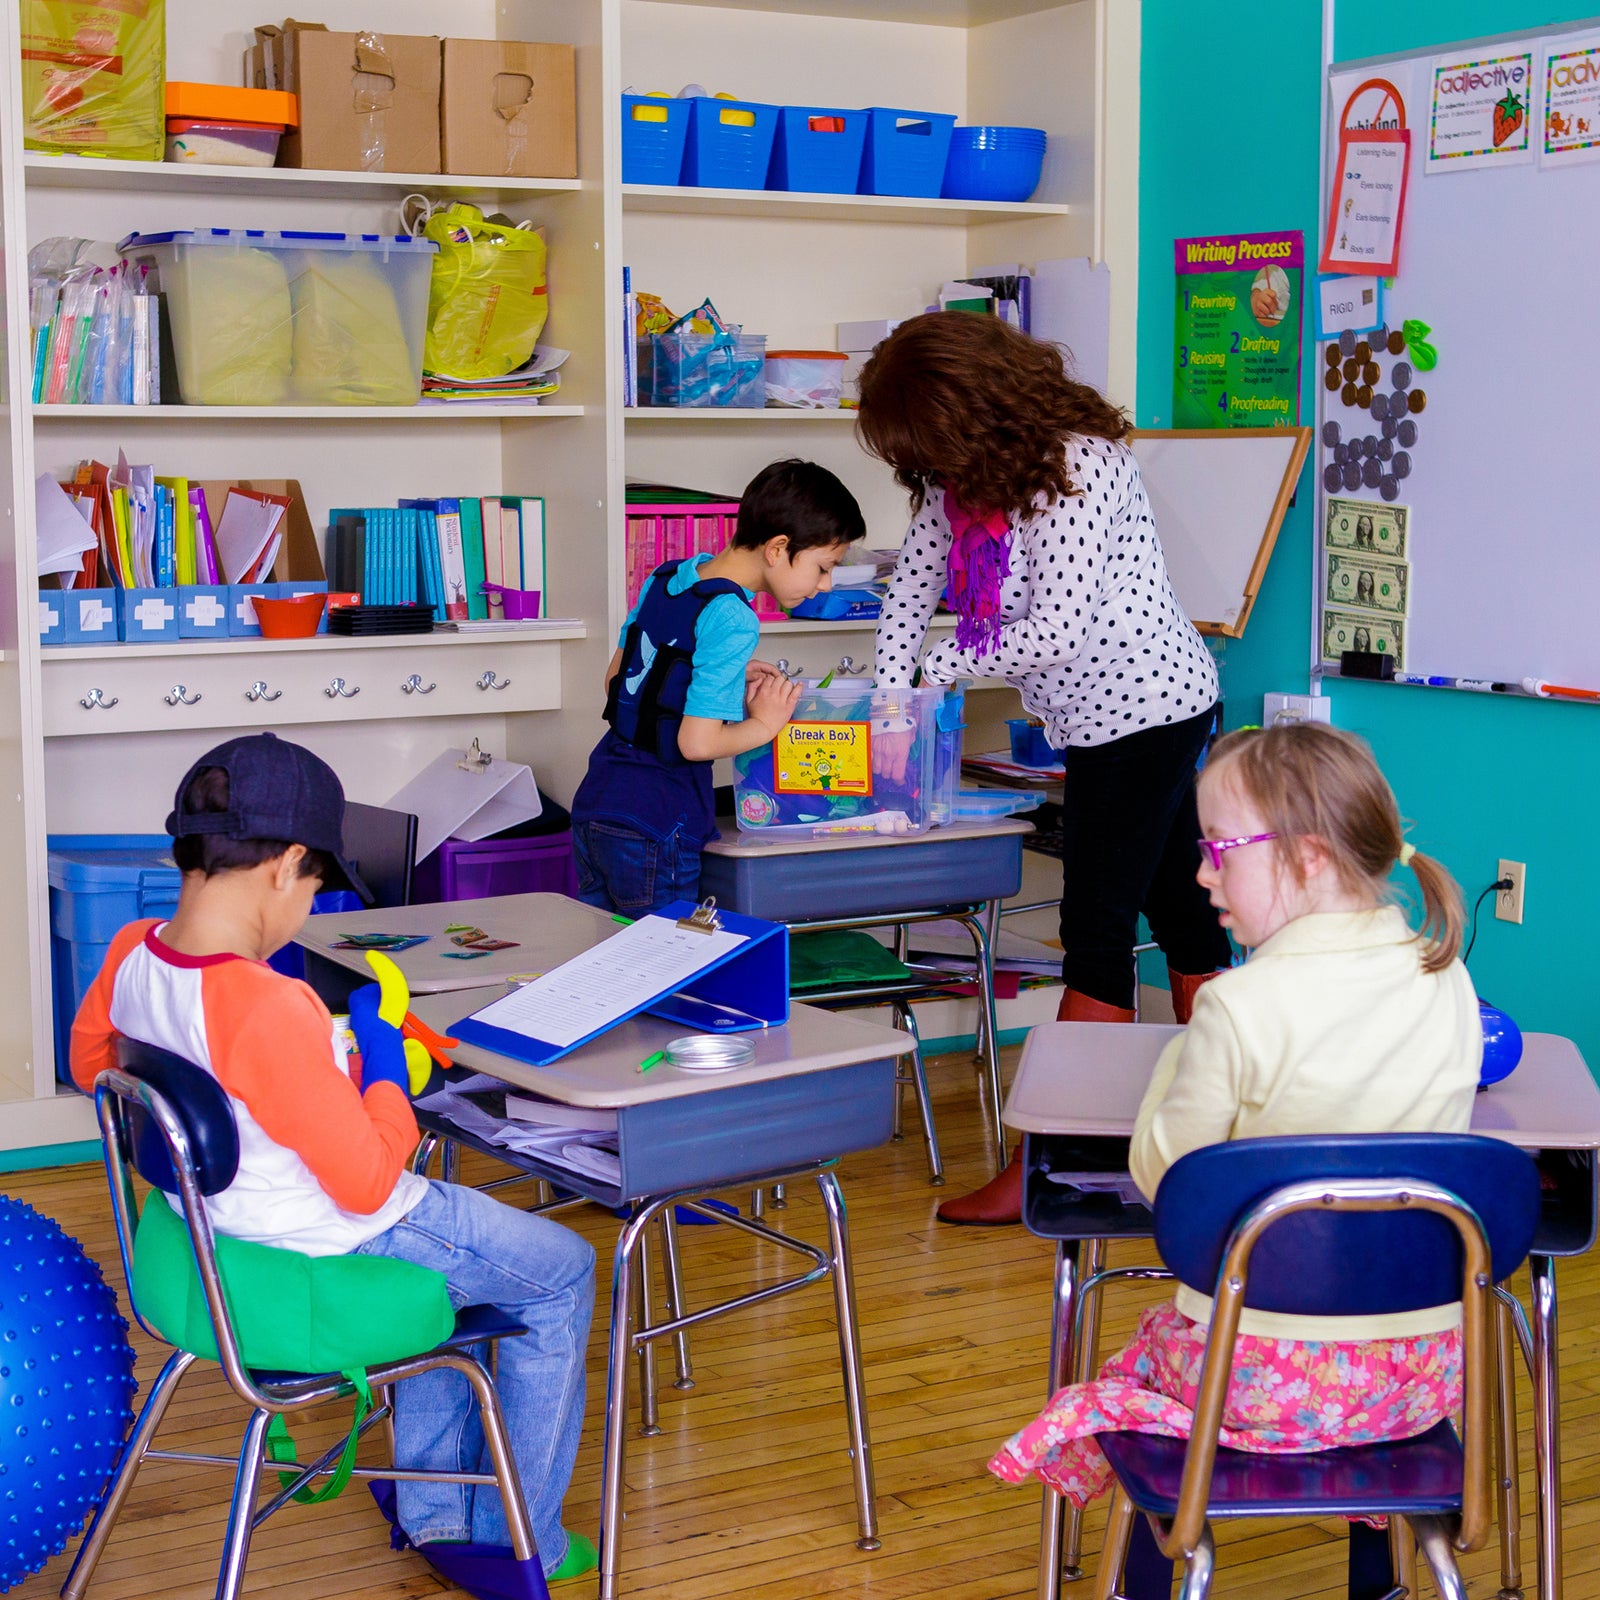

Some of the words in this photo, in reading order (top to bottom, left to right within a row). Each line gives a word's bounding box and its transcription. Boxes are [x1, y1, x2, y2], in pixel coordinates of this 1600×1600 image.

[1440, 66, 1524, 94] adjective
[1346, 118, 1398, 130] hining
[1360, 181, 1374, 190] Eyes
[1375, 182, 1393, 191] looking
[1356, 213, 1368, 221] Ears
[1369, 214, 1390, 224] listening
[1187, 241, 1236, 265] Writing
[1238, 240, 1292, 259] Process
[1350, 245, 1364, 254] Body
[1184, 290, 1189, 312] 1
[1191, 294, 1236, 310] Prewriting
[1330, 302, 1354, 315] RIGID
[1231, 332, 1239, 353] 2
[1241, 336, 1280, 354] Drafting
[1180, 346, 1188, 367] 3
[1190, 351, 1225, 367] Revising
[1218, 392, 1227, 413] 4
[1231, 395, 1289, 413] Proofreading
[446, 518, 454, 555] Dictionary
